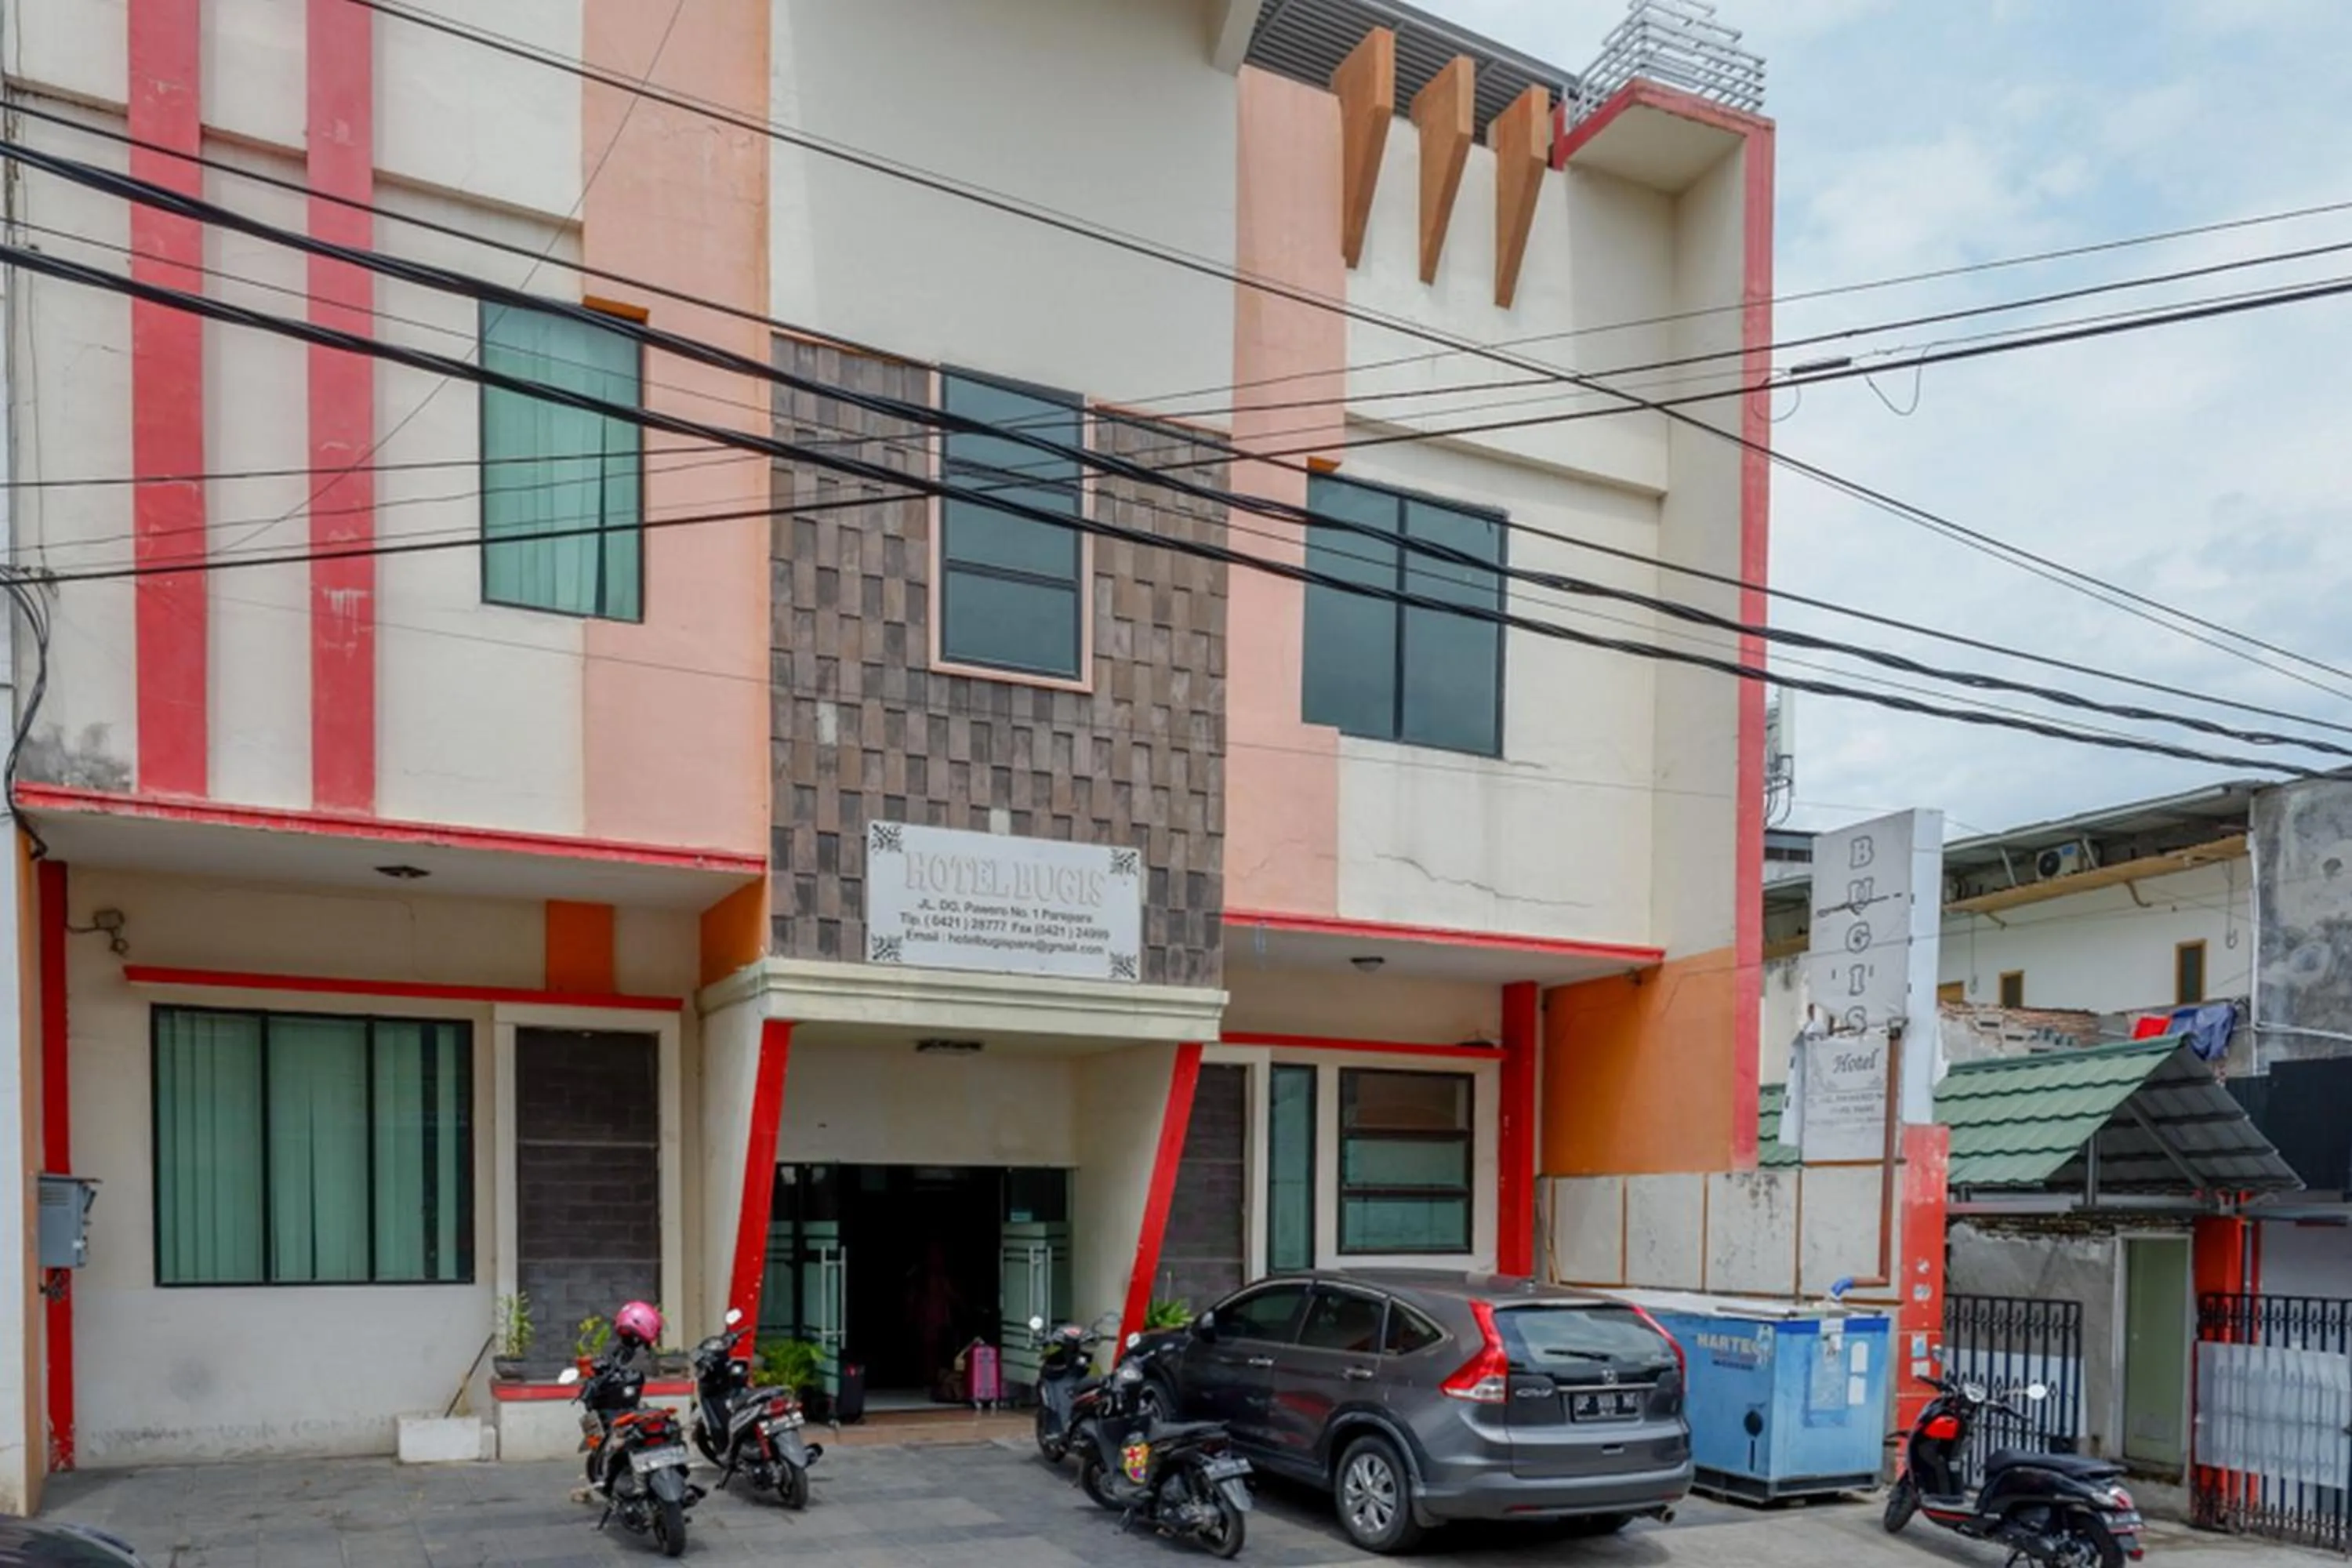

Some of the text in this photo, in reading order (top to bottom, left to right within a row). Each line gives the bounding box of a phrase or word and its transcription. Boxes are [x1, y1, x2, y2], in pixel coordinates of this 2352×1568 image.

[905, 851, 1106, 909] HOTEL BUGIS
[1832, 1047, 1879, 1074] Hotel
